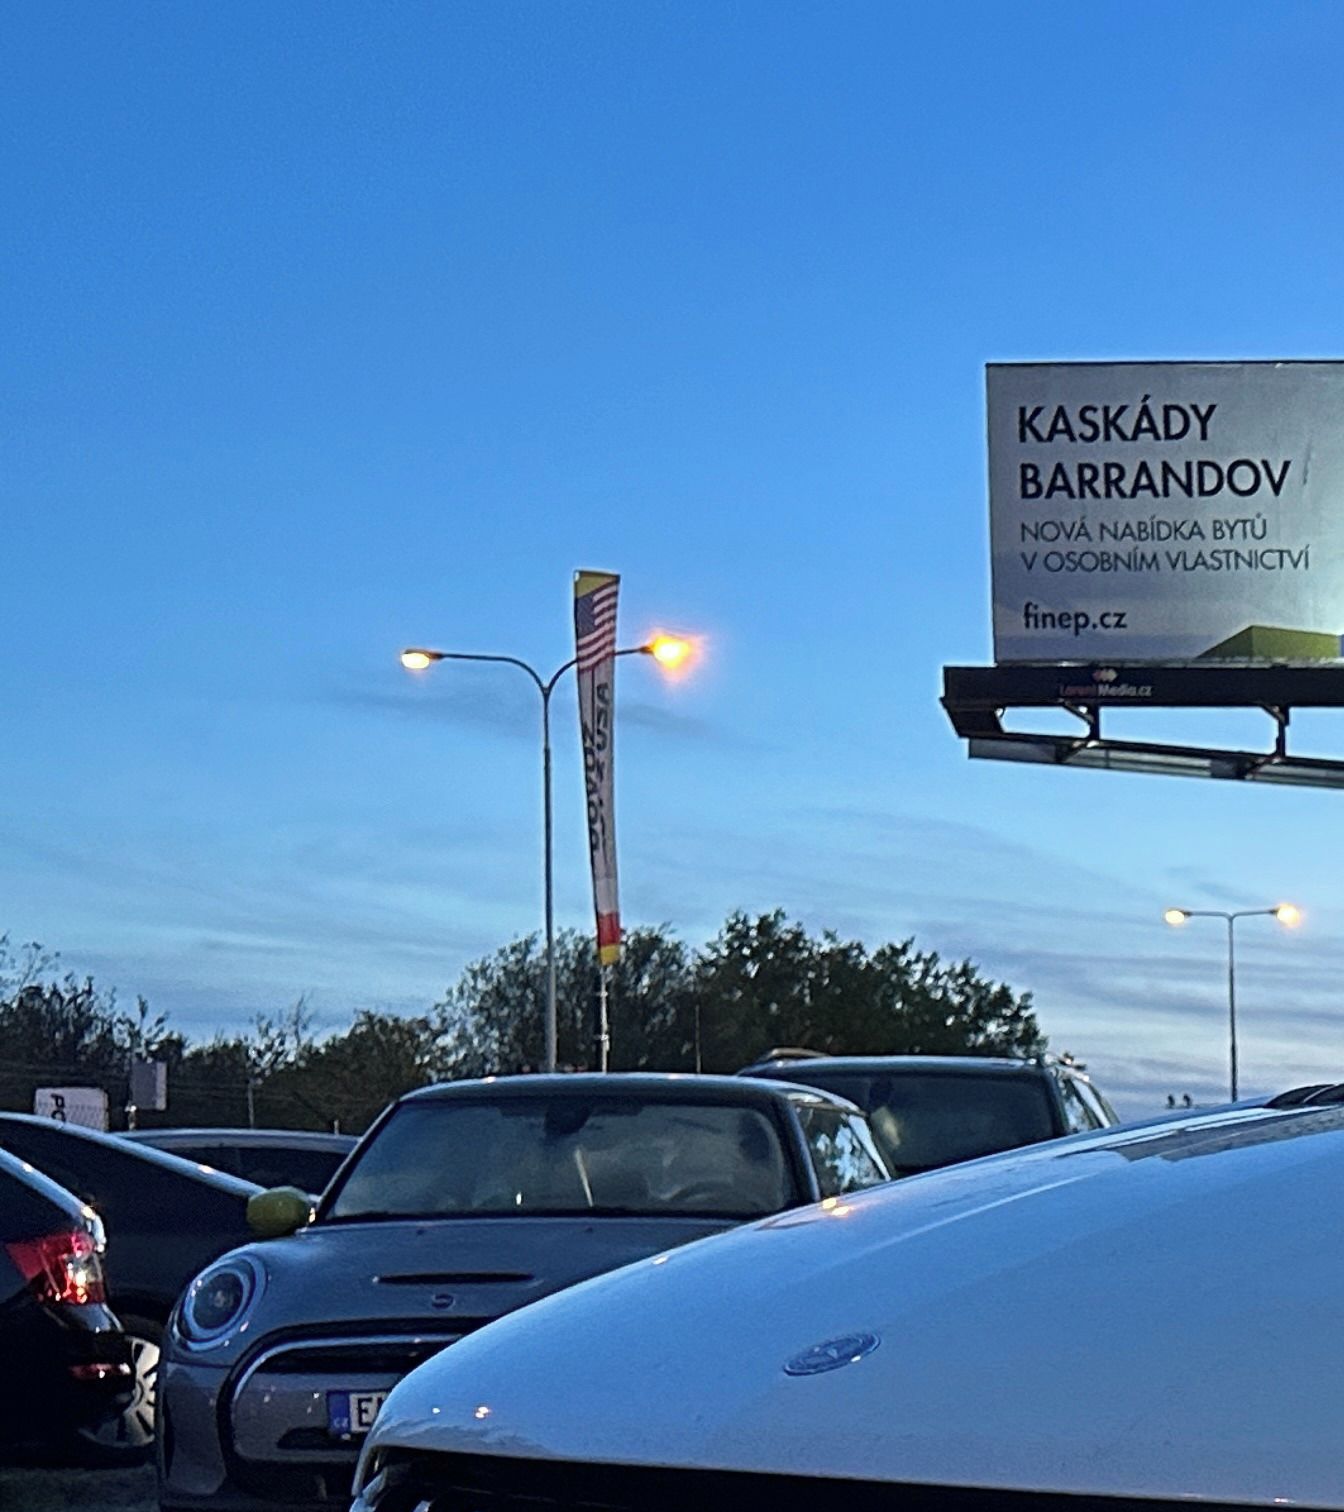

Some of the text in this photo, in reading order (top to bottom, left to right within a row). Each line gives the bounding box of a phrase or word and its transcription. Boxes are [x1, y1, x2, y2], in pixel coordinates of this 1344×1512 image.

[1018, 394, 1217, 442] KASKÁDY
[1019, 458, 1292, 499] BARRANDOV
[1020, 512, 1267, 543] NOVÁ NABÍDKA BYTŮ
[1020, 544, 1311, 573] V OSOBNÍM VLASTNICTVÍ
[1023, 601, 1128, 636] finep.cz
